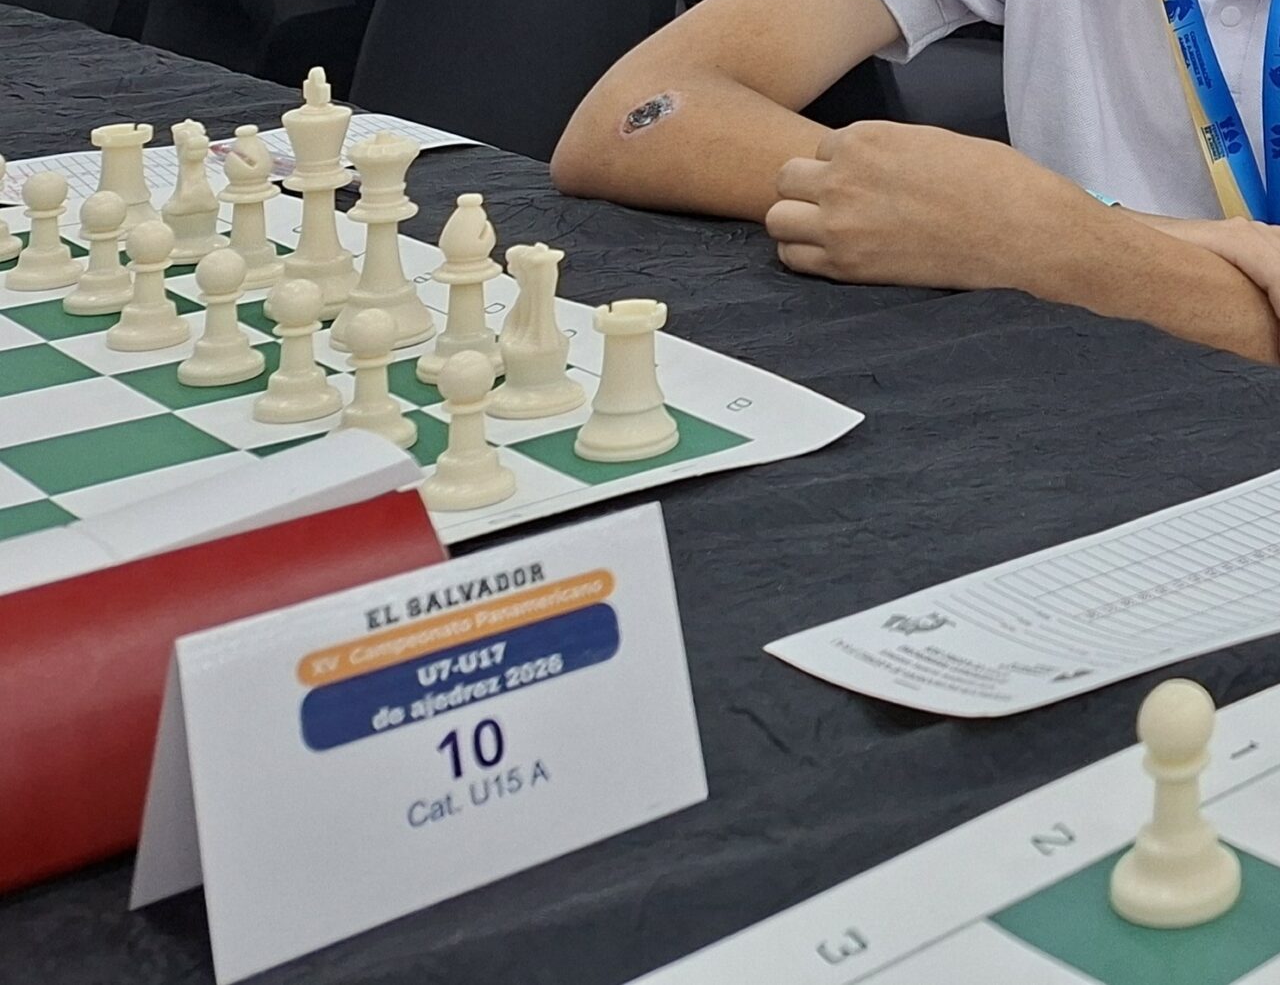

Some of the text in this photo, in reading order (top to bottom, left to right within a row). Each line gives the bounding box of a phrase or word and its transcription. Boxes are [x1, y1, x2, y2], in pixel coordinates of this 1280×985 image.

[365, 563, 546, 631] EL SALVADOR
[311, 578, 604, 676] XV Campeonato Panamericano
[416, 641, 508, 687] U7-U17
[371, 705, 406, 731] de
[410, 675, 502, 720] ajedrez
[436, 718, 506, 779] 10
[407, 760, 551, 828] Cat. U15 A
[1031, 821, 1077, 857] 2
[815, 927, 870, 966] 3
